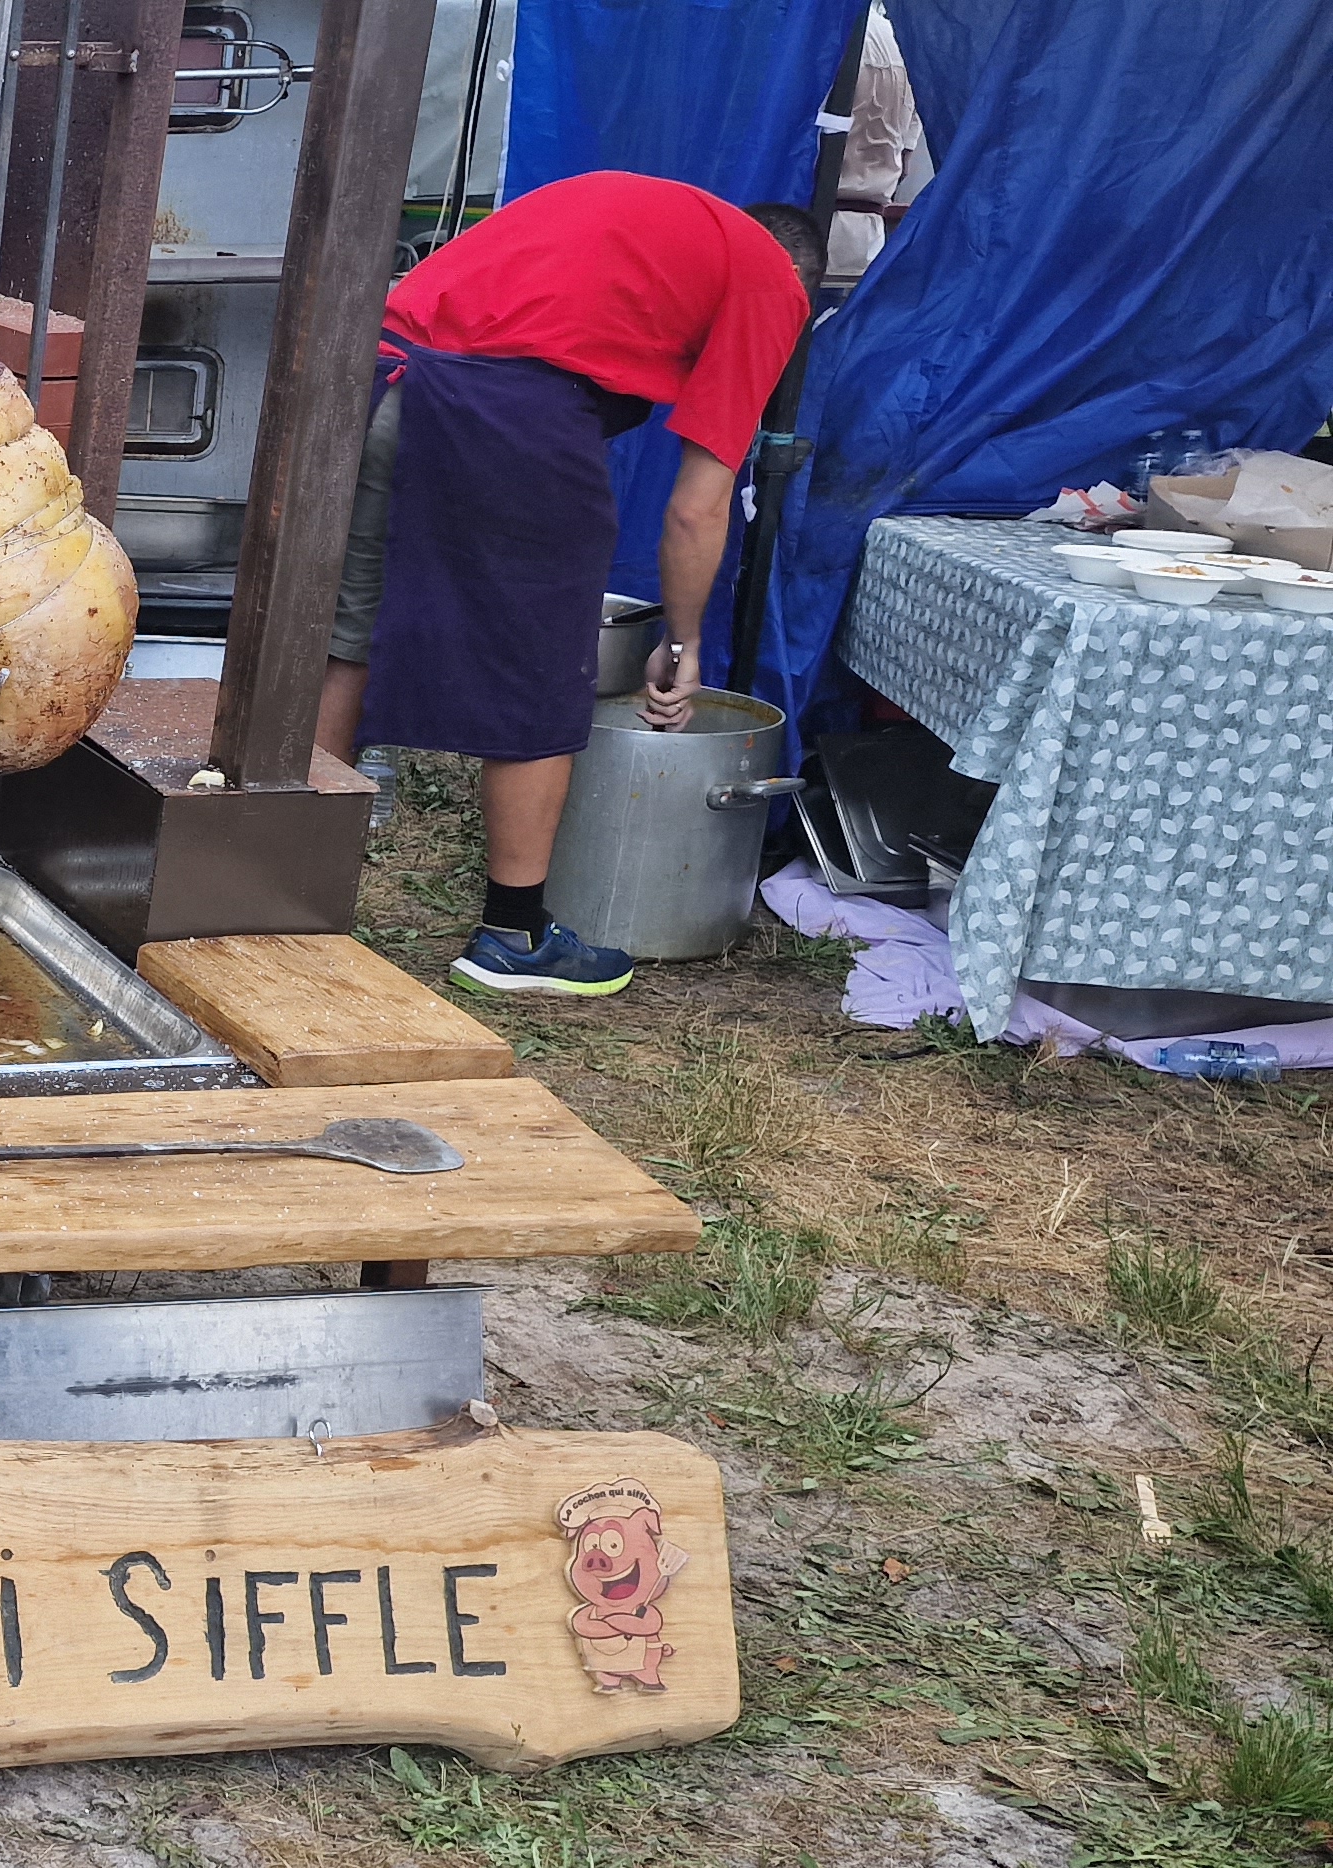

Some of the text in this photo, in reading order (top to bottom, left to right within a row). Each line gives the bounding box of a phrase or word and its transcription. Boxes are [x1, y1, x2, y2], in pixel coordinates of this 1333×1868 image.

[561, 1487, 651, 1522] Le cochon qui siffle
